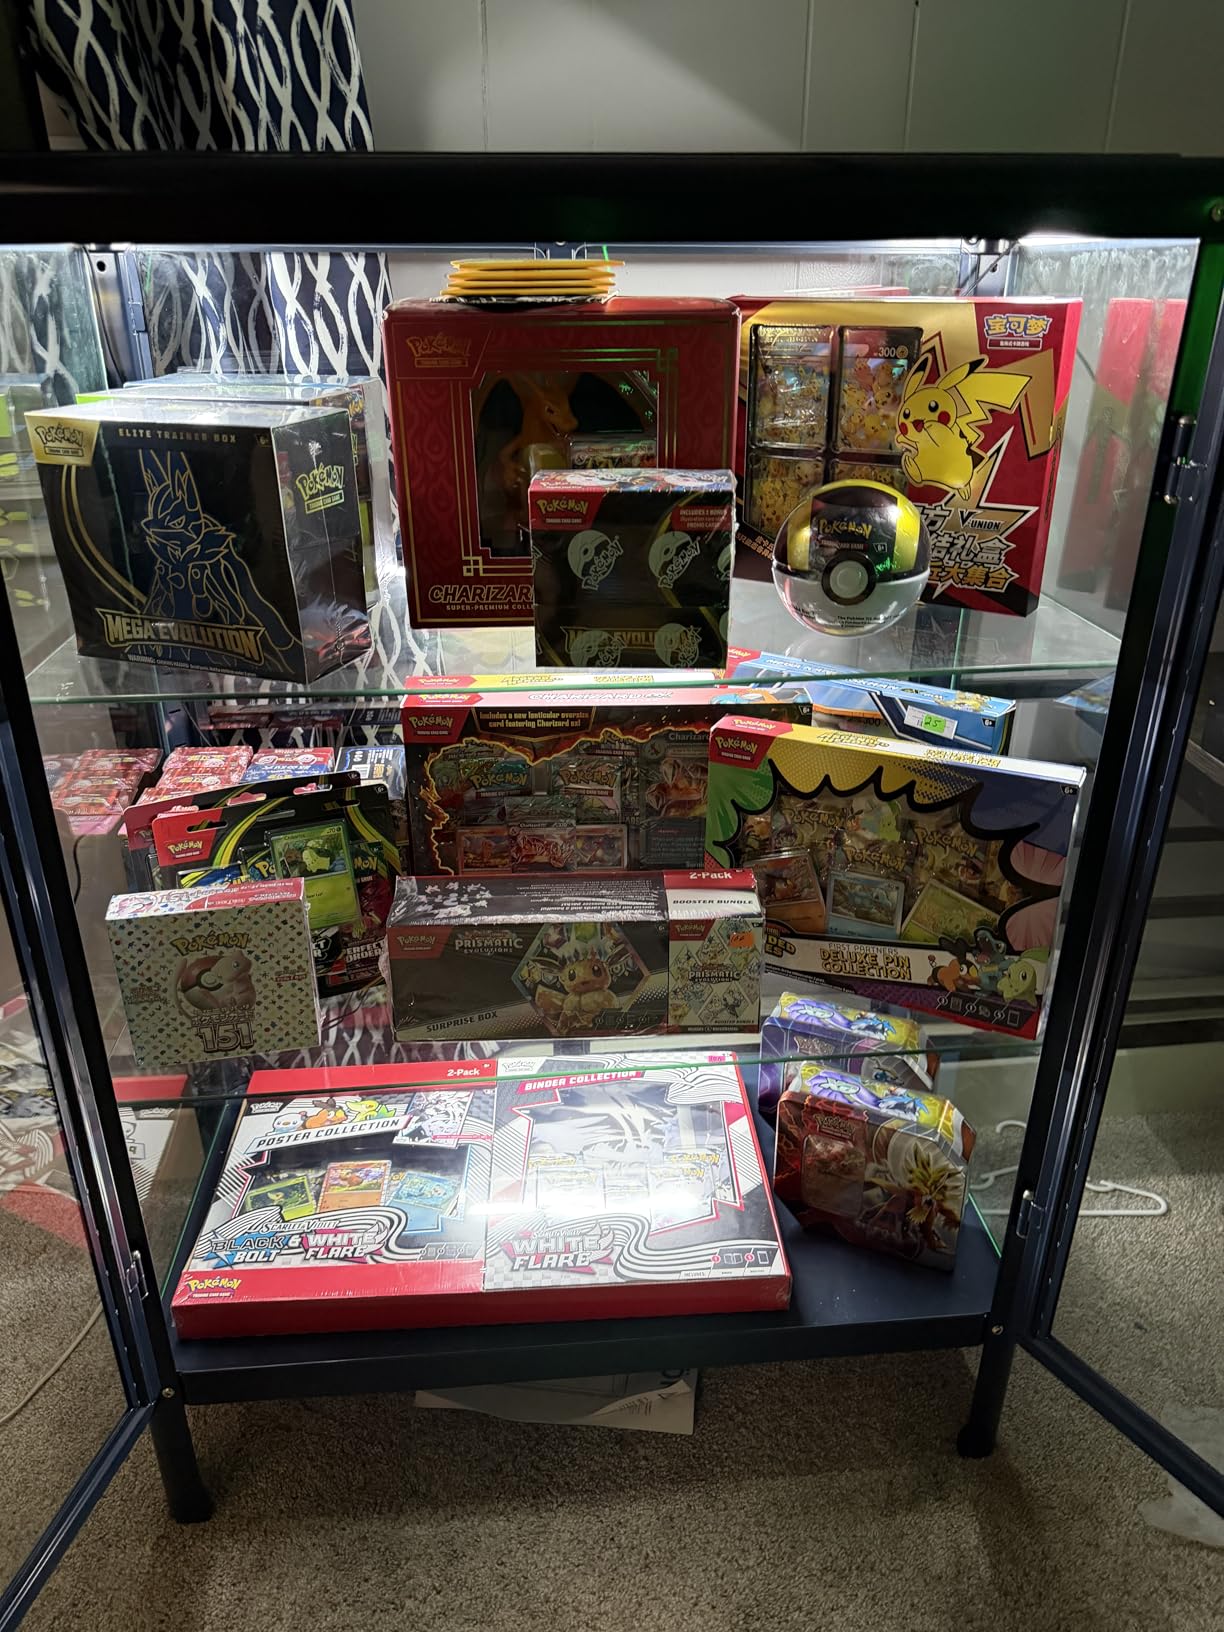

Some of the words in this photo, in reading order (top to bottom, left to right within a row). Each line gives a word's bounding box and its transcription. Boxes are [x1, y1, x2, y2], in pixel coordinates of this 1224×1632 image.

[984, 314, 1052, 337] 宝可梦
[34, 423, 84, 447] Pokémon
[118, 428, 151, 439] ELITE
[156, 430, 208, 442] TRAINER
[213, 432, 237, 444] BOX
[295, 462, 345, 500] Pokémon
[536, 496, 589, 515] Pokémon
[818, 518, 873, 540] Pokémon
[581, 536, 625, 591] Pokémon
[658, 537, 701, 590] Pokémon
[428, 584, 535, 604] CHARIZAR
[105, 613, 154, 643] MEGA
[158, 621, 260, 663] EVOLUTION
[408, 713, 454, 730] Pokémon
[480, 711, 507, 719] Includes
[528, 711, 560, 719] lenticular
[489, 719, 504, 727] card
[505, 719, 536, 728] featuring
[537, 719, 569, 727] Charizard
[924, 716, 941, 727] 25
[715, 736, 758, 754] Pokémon
[470, 770, 527, 789] Pokémon
[559, 769, 618, 787] Pokémon
[782, 808, 846, 829] Pokémon
[168, 840, 203, 854] Pokémon
[914, 826, 979, 857] Pokémon
[845, 847, 906, 870] Pokémon
[688, 871, 733, 880] 2-Pack
[169, 931, 251, 957] Pokémon
[346, 940, 385, 955] ERFECT
[396, 934, 437, 946] Pokémon
[454, 938, 525, 949] PRISMATIC
[828, 943, 852, 951] FIRST
[854, 944, 900, 956] PARTNERS
[820, 949, 878, 966] DELUXE
[883, 954, 911, 968] PIN
[689, 971, 741, 980] PRISMATIC
[822, 962, 912, 981] COLLECTION
[426, 1015, 475, 1033] SURPRISE
[477, 1010, 498, 1022] BOX
[201, 1021, 255, 1051] 151
[447, 1068, 480, 1077] 2-Pack
[525, 1078, 566, 1091] BINDER
[569, 1070, 637, 1085] COLLECTION
[256, 1132, 311, 1149] POSTER
[314, 1118, 400, 1138] COLLECTION
[259, 1221, 301, 1234] SCARLET
[212, 1236, 286, 1252] BLACK
[287, 1234, 301, 1249] &
[307, 1232, 379, 1247] WHITE
[511, 1234, 602, 1255] WHITE
[233, 1249, 281, 1263] BOLT
[305, 1245, 367, 1260] FLARE
[511, 1251, 593, 1272] FLARE
[187, 1276, 242, 1292] Pokémon
